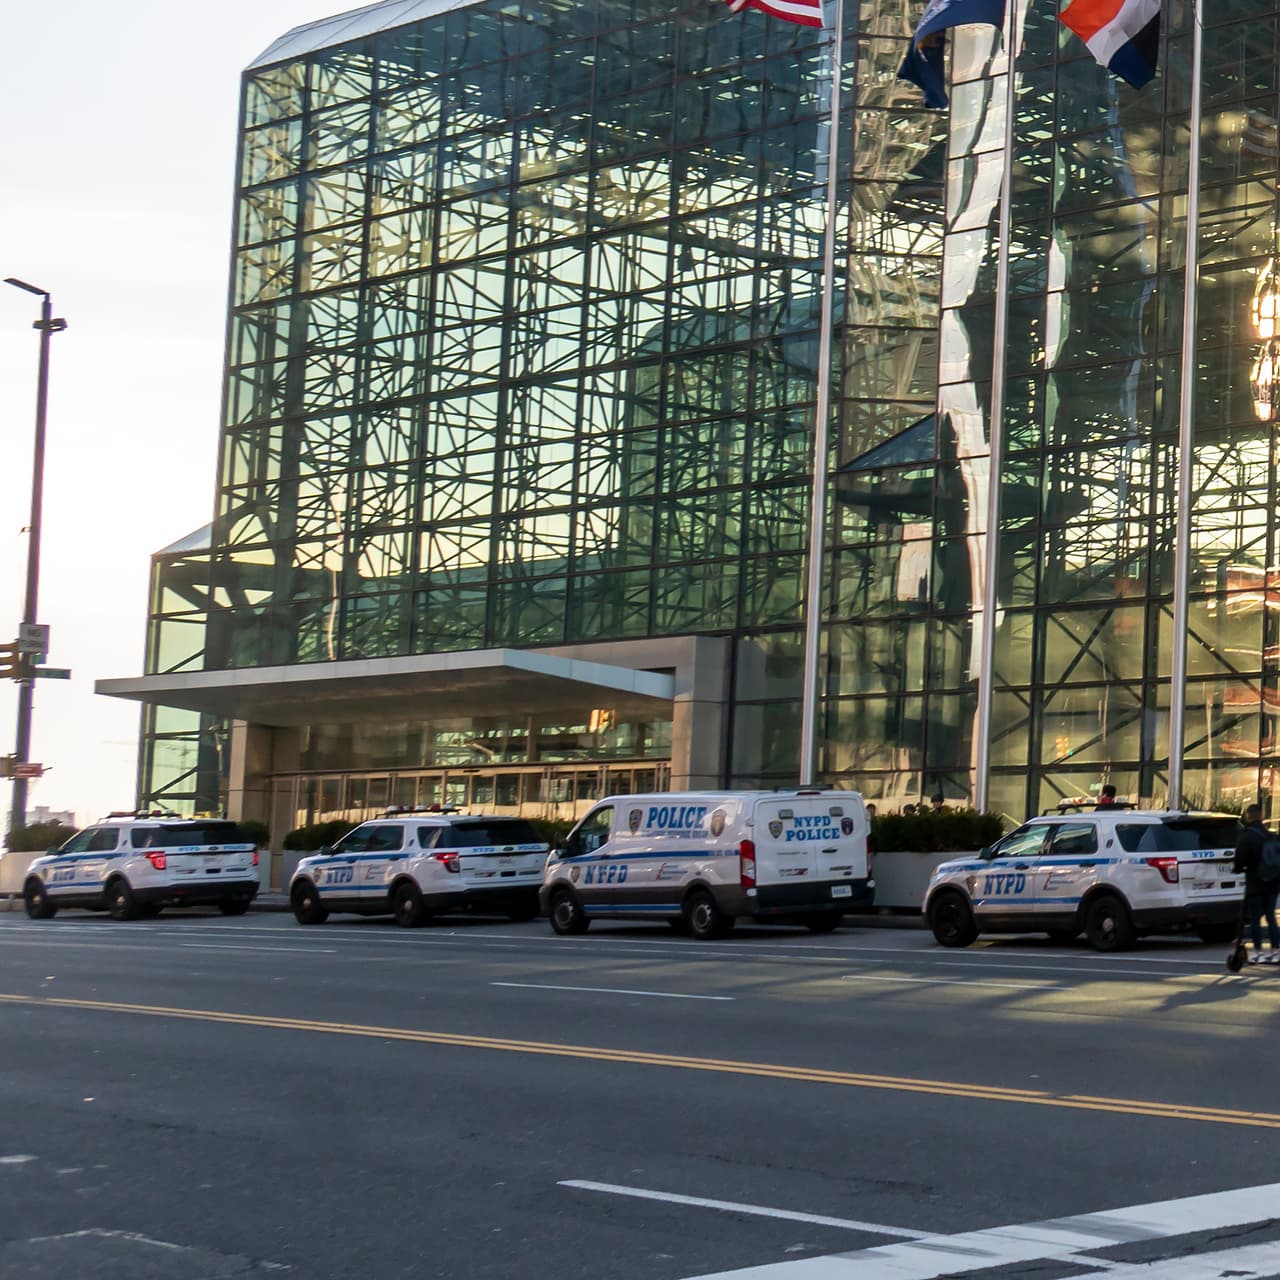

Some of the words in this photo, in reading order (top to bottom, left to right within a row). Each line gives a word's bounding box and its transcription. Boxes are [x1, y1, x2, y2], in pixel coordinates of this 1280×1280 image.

[646, 806, 708, 829] POLICE
[793, 815, 832, 828] NYPD
[785, 827, 841, 842] POLICE
[1191, 850, 1215, 858] NYPD
[584, 864, 629, 885] NYPD
[983, 873, 1026, 895] NYPD
